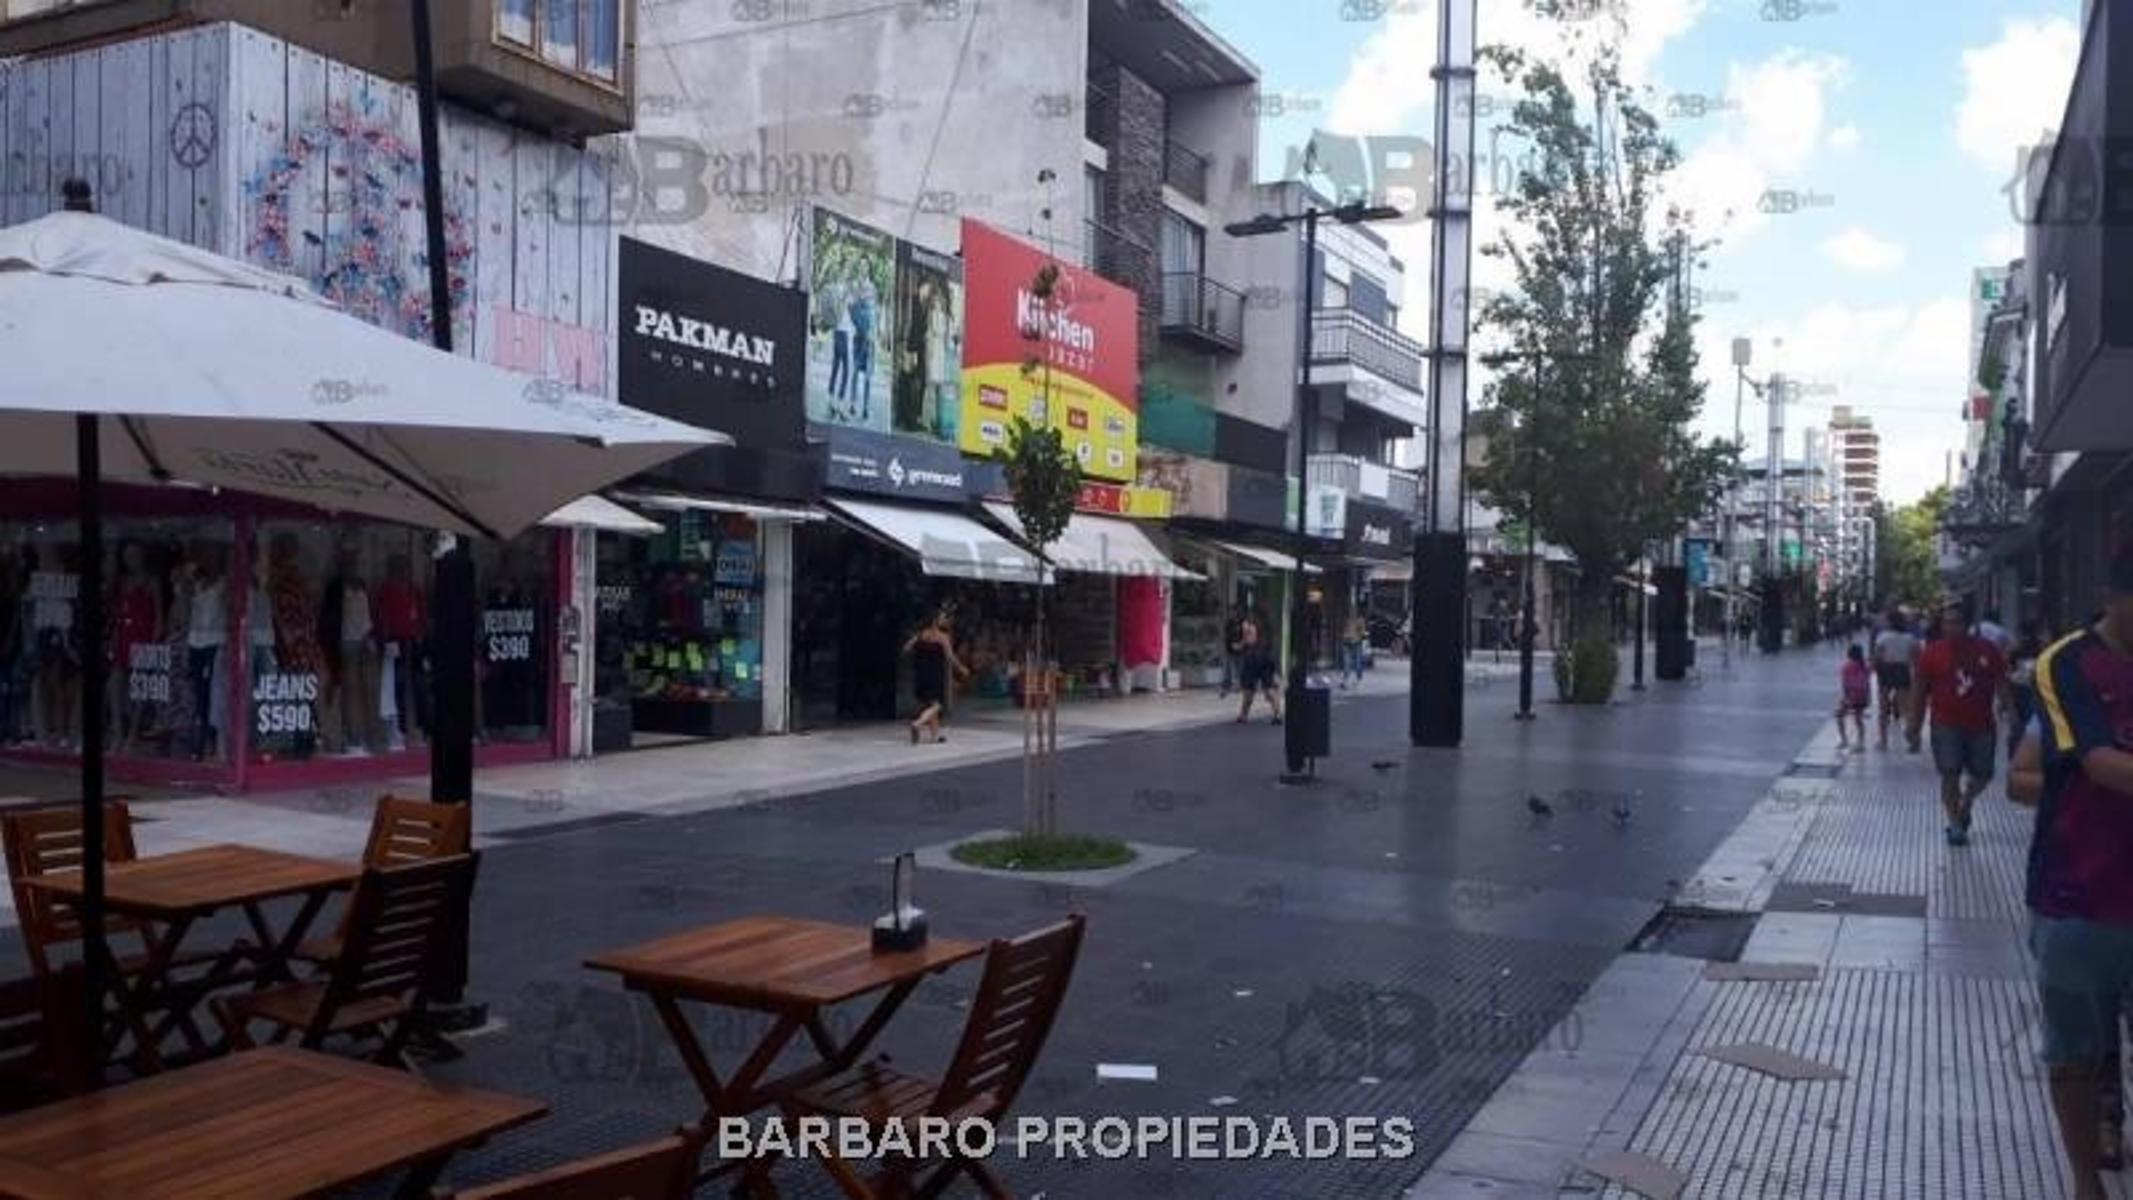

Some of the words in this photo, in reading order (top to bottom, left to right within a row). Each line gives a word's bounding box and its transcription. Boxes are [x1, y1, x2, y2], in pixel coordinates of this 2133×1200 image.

[635, 304, 774, 366] PAKMAN
[253, 674, 318, 701] JEANS
[258, 704, 311, 733] $590
